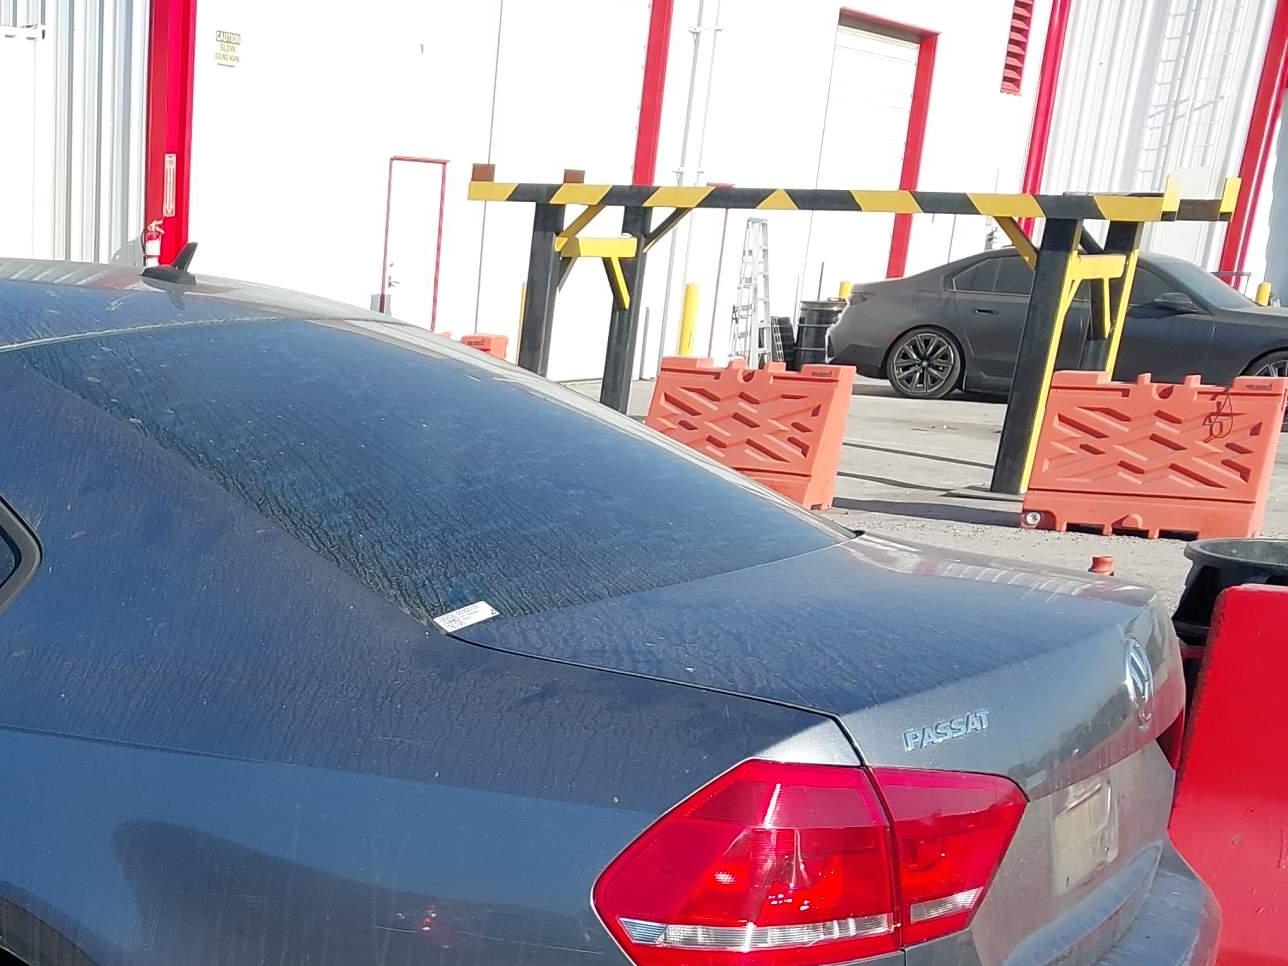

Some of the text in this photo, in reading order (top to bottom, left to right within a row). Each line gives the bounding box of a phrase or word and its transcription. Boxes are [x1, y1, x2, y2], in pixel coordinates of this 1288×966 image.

[216, 31, 240, 44] CAUTION
[220, 43, 236, 53] SLOW
[903, 708, 989, 752] PASSAT
